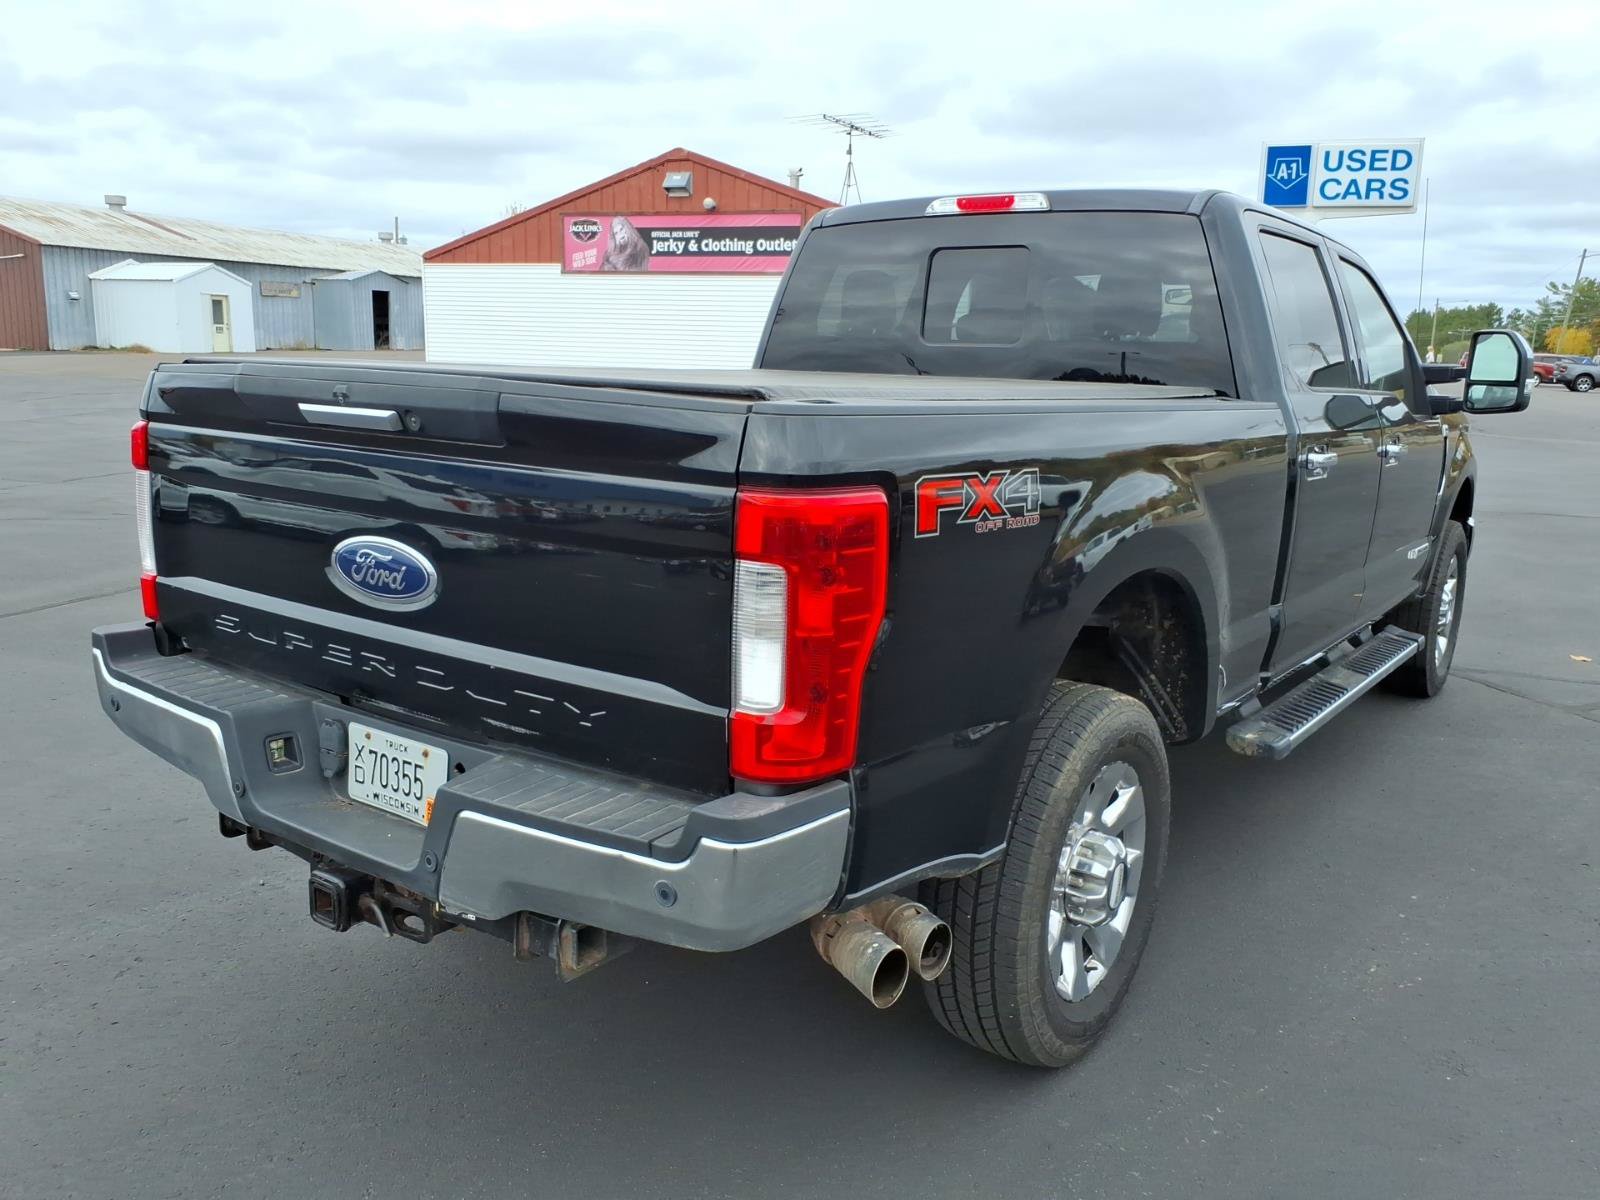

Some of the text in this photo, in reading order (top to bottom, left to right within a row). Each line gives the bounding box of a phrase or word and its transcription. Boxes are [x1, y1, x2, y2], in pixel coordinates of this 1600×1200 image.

[1323, 149, 1412, 172] USED
[1319, 178, 1409, 200] CARS
[651, 239, 686, 254] Jerky
[688, 240, 698, 251] &
[701, 238, 754, 254] Clothing
[914, 468, 1041, 538] FX4
[975, 515, 1040, 533] OFF ROAD
[351, 549, 405, 591] Ford
[215, 614, 607, 727] SUPER DUTY
[386, 740, 408, 752] TRUCK
[369, 749, 424, 800] 70355
[373, 793, 419, 814] WISCONSIN
